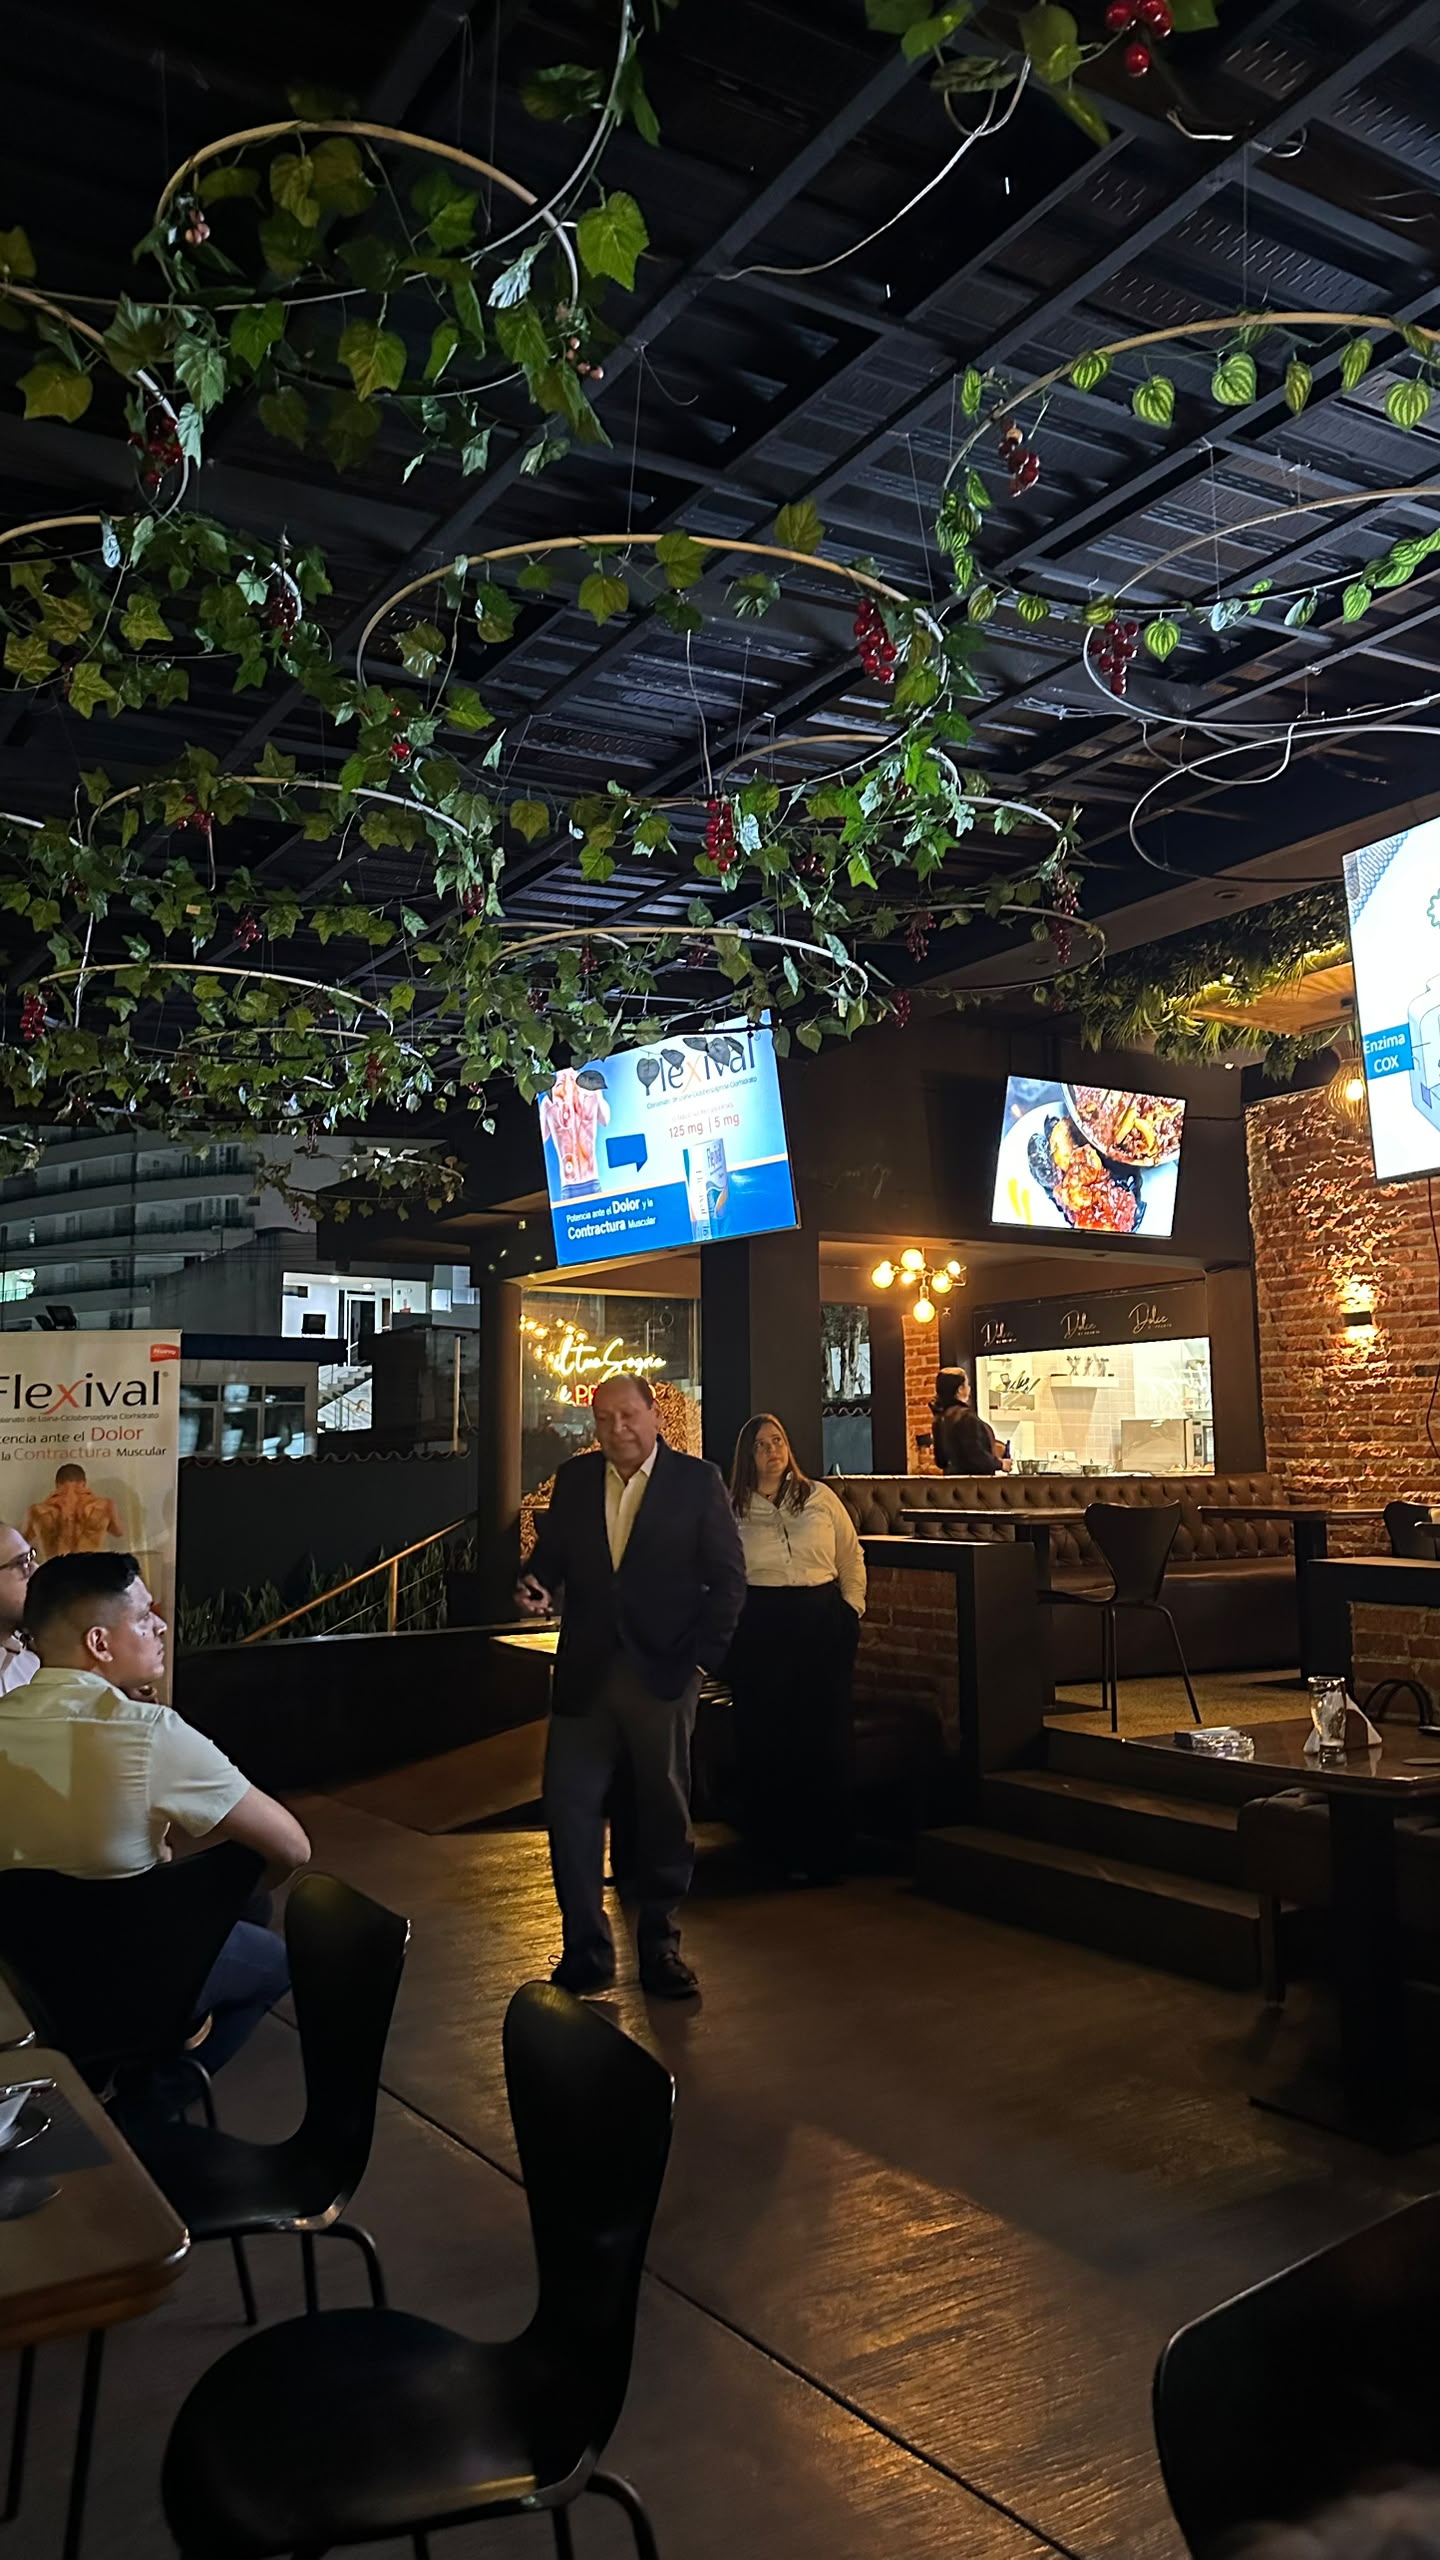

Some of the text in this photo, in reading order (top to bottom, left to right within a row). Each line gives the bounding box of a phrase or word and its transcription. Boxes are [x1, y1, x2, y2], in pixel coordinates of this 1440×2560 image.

[1363, 1033, 1406, 1054] Enzima
[638, 1034, 755, 1094] lexival
[1374, 1055, 1399, 1073] COX
[669, 1122, 704, 1138] 125 mg
[715, 1113, 740, 1128] 5 mg
[566, 1197, 654, 1223] Potencia ante el Dolor y la
[567, 1216, 657, 1240] Contractura Muscular
[1060, 1310, 1097, 1340] Dolce
[1128, 1302, 1169, 1334] Dolce
[40, 1433, 70, 1444] ante
[73, 1431, 85, 1442] el
[91, 1426, 144, 1442] Dolor
[1, 1446, 167, 1461] la Contractura Muscular
